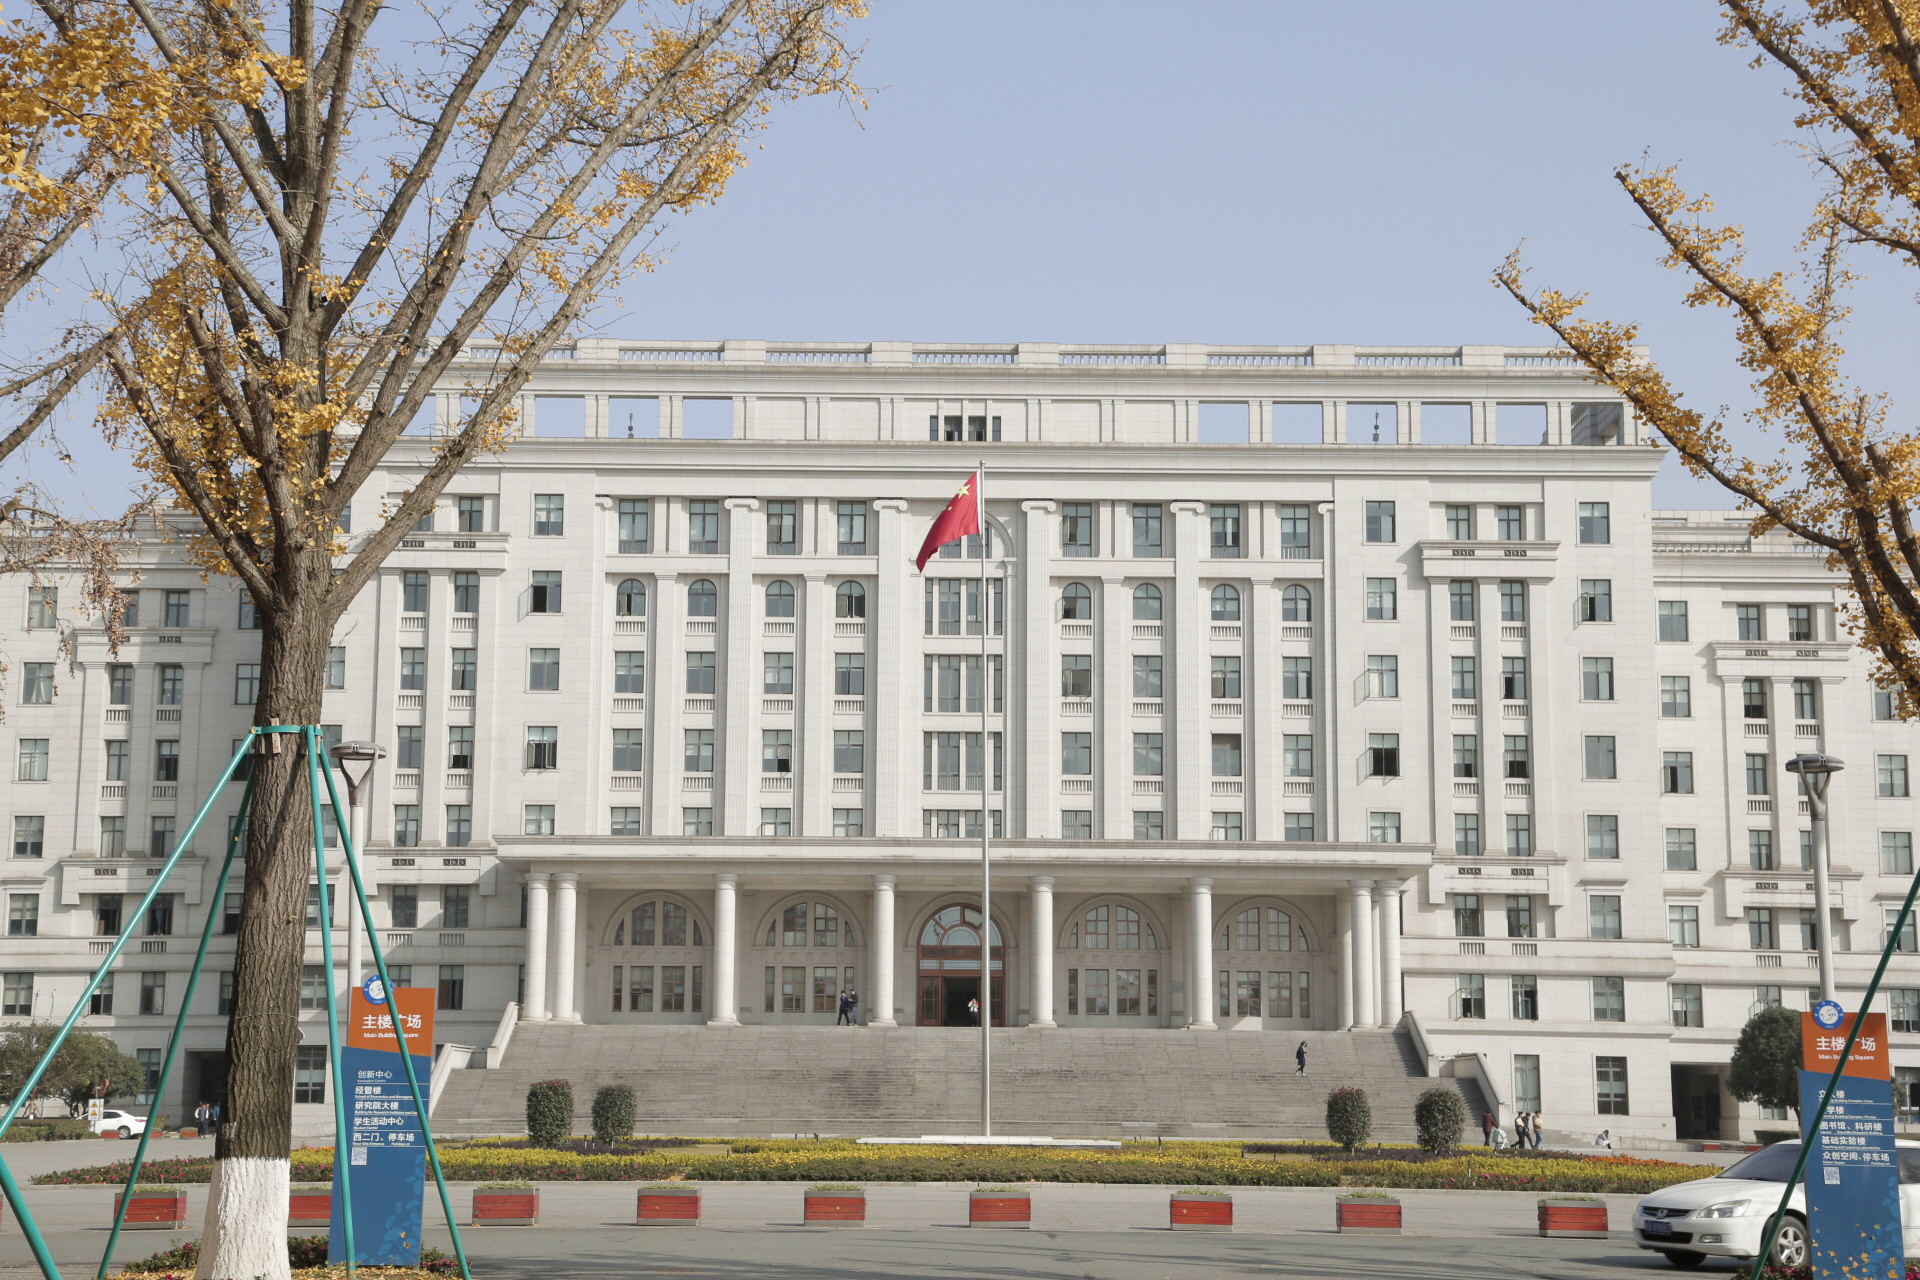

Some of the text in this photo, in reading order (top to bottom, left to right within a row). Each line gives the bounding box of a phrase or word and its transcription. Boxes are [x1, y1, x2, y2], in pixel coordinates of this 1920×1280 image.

[1816, 1036, 1876, 1051] 主楼场
[358, 1070, 392, 1079] 创新中心
[355, 1086, 382, 1094] 经管楼
[355, 1101, 399, 1110] 研究院大楼
[1819, 1106, 1845, 1114] 学楼
[354, 1117, 404, 1126] 学生活动中心
[1822, 1136, 1866, 1145] 基础实验楼
